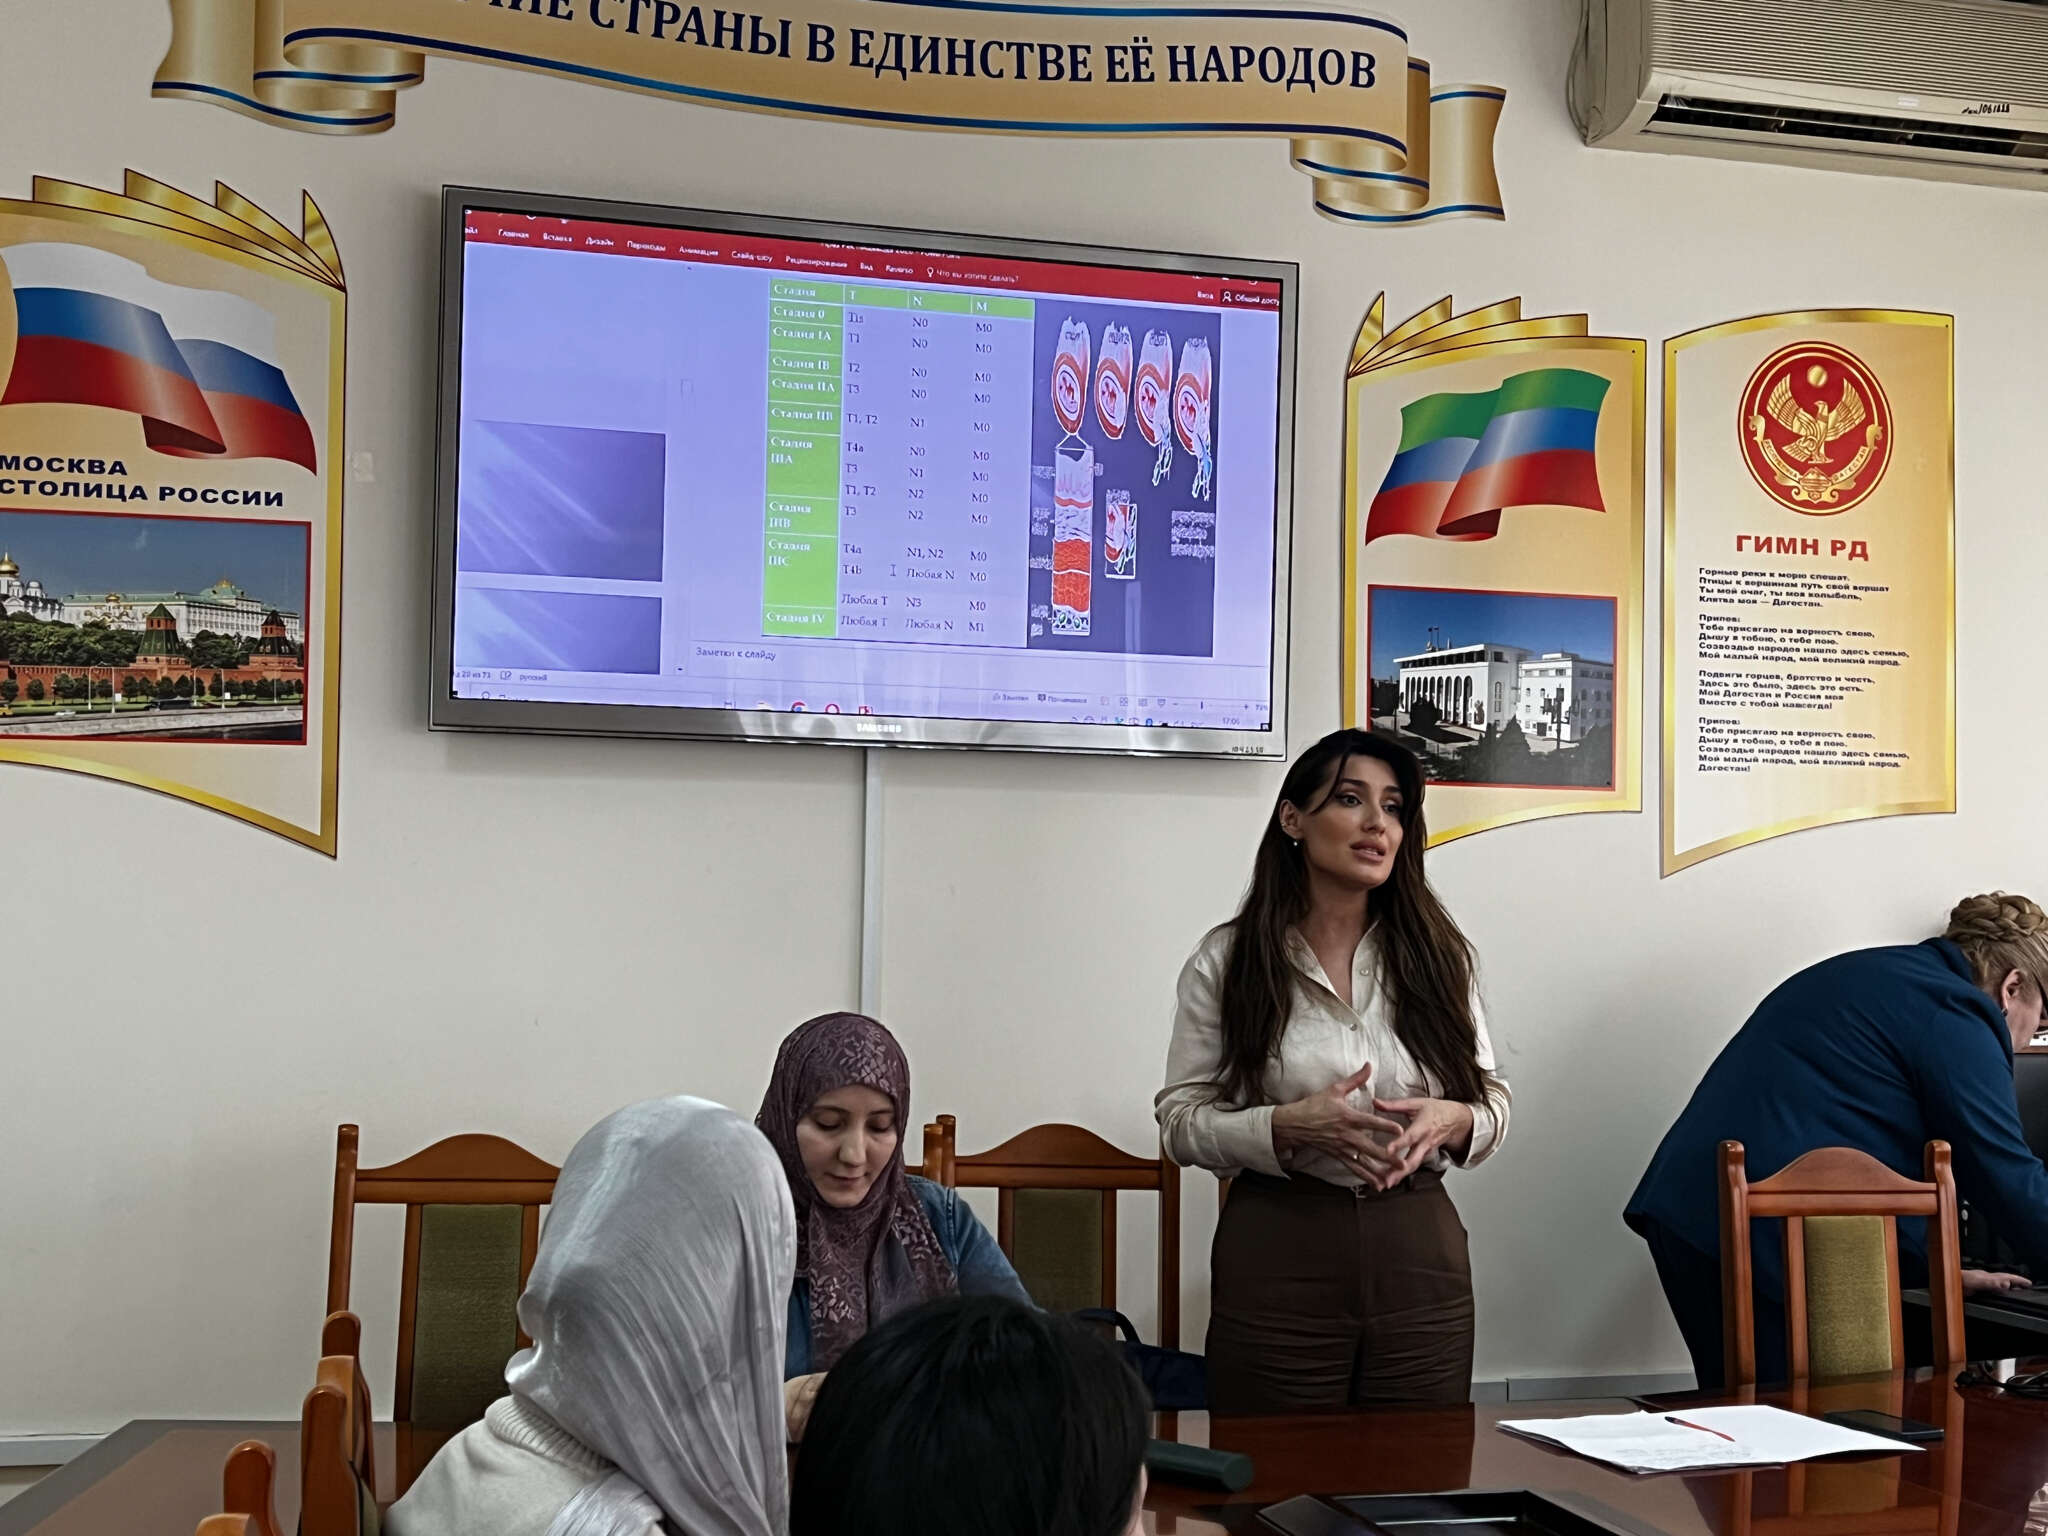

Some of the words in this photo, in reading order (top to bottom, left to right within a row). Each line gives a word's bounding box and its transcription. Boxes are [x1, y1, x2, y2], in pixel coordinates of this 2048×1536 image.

[589, 0, 791, 58] СТРАНЫ
[806, 23, 836, 63] В
[848, 28, 1093, 81] ЕДИНСТВЕ
[1104, 36, 1155, 83] ЕЁ
[1166, 45, 1376, 92] НАРОДОВ
[774, 285, 816, 297] Стадия
[849, 290, 855, 300] T
[914, 297, 923, 306] N
[977, 302, 987, 311] M
[774, 306, 814, 318] Стадия
[912, 318, 928, 327] N0
[773, 327, 813, 339] Стадия
[976, 323, 992, 333] M0
[849, 333, 860, 343] T1
[912, 339, 928, 348] N0
[975, 344, 992, 353] M0
[773, 357, 814, 369] Стадия
[848, 363, 860, 372] T2
[912, 368, 927, 377] N0
[975, 373, 991, 382] M0
[772, 378, 814, 391] Стадия
[848, 384, 860, 394] T3
[912, 390, 927, 399] N0
[974, 394, 991, 403] M0
[771, 408, 814, 420] Стадия
[866, 415, 878, 425] T2
[911, 418, 924, 427] N1
[974, 423, 990, 432] M0
[771, 437, 813, 449] Стадия
[846, 443, 864, 452] T4a
[910, 447, 925, 456] N0
[973, 452, 989, 461] M0
[0, 455, 127, 476] МОСКВА
[846, 464, 858, 473] T3
[910, 468, 923, 478] N1
[972, 472, 989, 482] M0
[0, 478, 148, 502] СТОЛИЦА
[159, 486, 283, 507] РОССИИ
[864, 486, 876, 496] T2
[909, 489, 924, 499] N2
[972, 494, 988, 503] M0
[769, 502, 811, 514] Стадия
[845, 507, 856, 516] T3
[909, 511, 924, 520] N2
[971, 515, 988, 524] M0
[769, 539, 811, 551] Стадия
[844, 544, 861, 554] T4a
[1736, 534, 1819, 556] ГИМН
[1830, 539, 1869, 561] РД
[929, 549, 944, 559] N2
[970, 552, 987, 561] M0
[907, 568, 942, 580] Любая
[945, 571, 955, 580] N
[970, 572, 986, 582] M0
[1699, 567, 1738, 576] Горные
[1778, 572, 1807, 580] морю
[1699, 576, 1732, 586] Птицы
[1744, 580, 1798, 588] вершинам
[1801, 582, 1823, 590] путь
[1699, 585, 1714, 593] Ты
[1785, 591, 1805, 599] моя
[841, 594, 878, 606] Любая
[906, 598, 921, 607] N3
[1698, 595, 1734, 603] Клятва
[969, 601, 986, 611] M0
[766, 612, 808, 623] Стадия
[841, 616, 878, 627] Любая
[906, 619, 941, 630] Любая
[944, 621, 953, 630] N
[969, 622, 984, 632] M1
[1698, 622, 1724, 631] Тебе
[1796, 628, 1843, 636] верность
[1698, 632, 1729, 642] Дышу
[1788, 636, 1811, 644] тебе
[696, 647, 735, 657] Заметки
[1699, 641, 1754, 651] Созвездье
[1758, 645, 1800, 653] народов
[1699, 650, 1720, 658] Мой
[1699, 669, 1742, 678] Подвиги
[1786, 673, 1832, 681] братство
[1699, 679, 1729, 687] Здесь
[1699, 688, 1720, 696] Мой
[1723, 689, 1771, 698] Дагестан
[1784, 691, 1821, 700] Россия
[1699, 698, 1737, 706] Вместе
